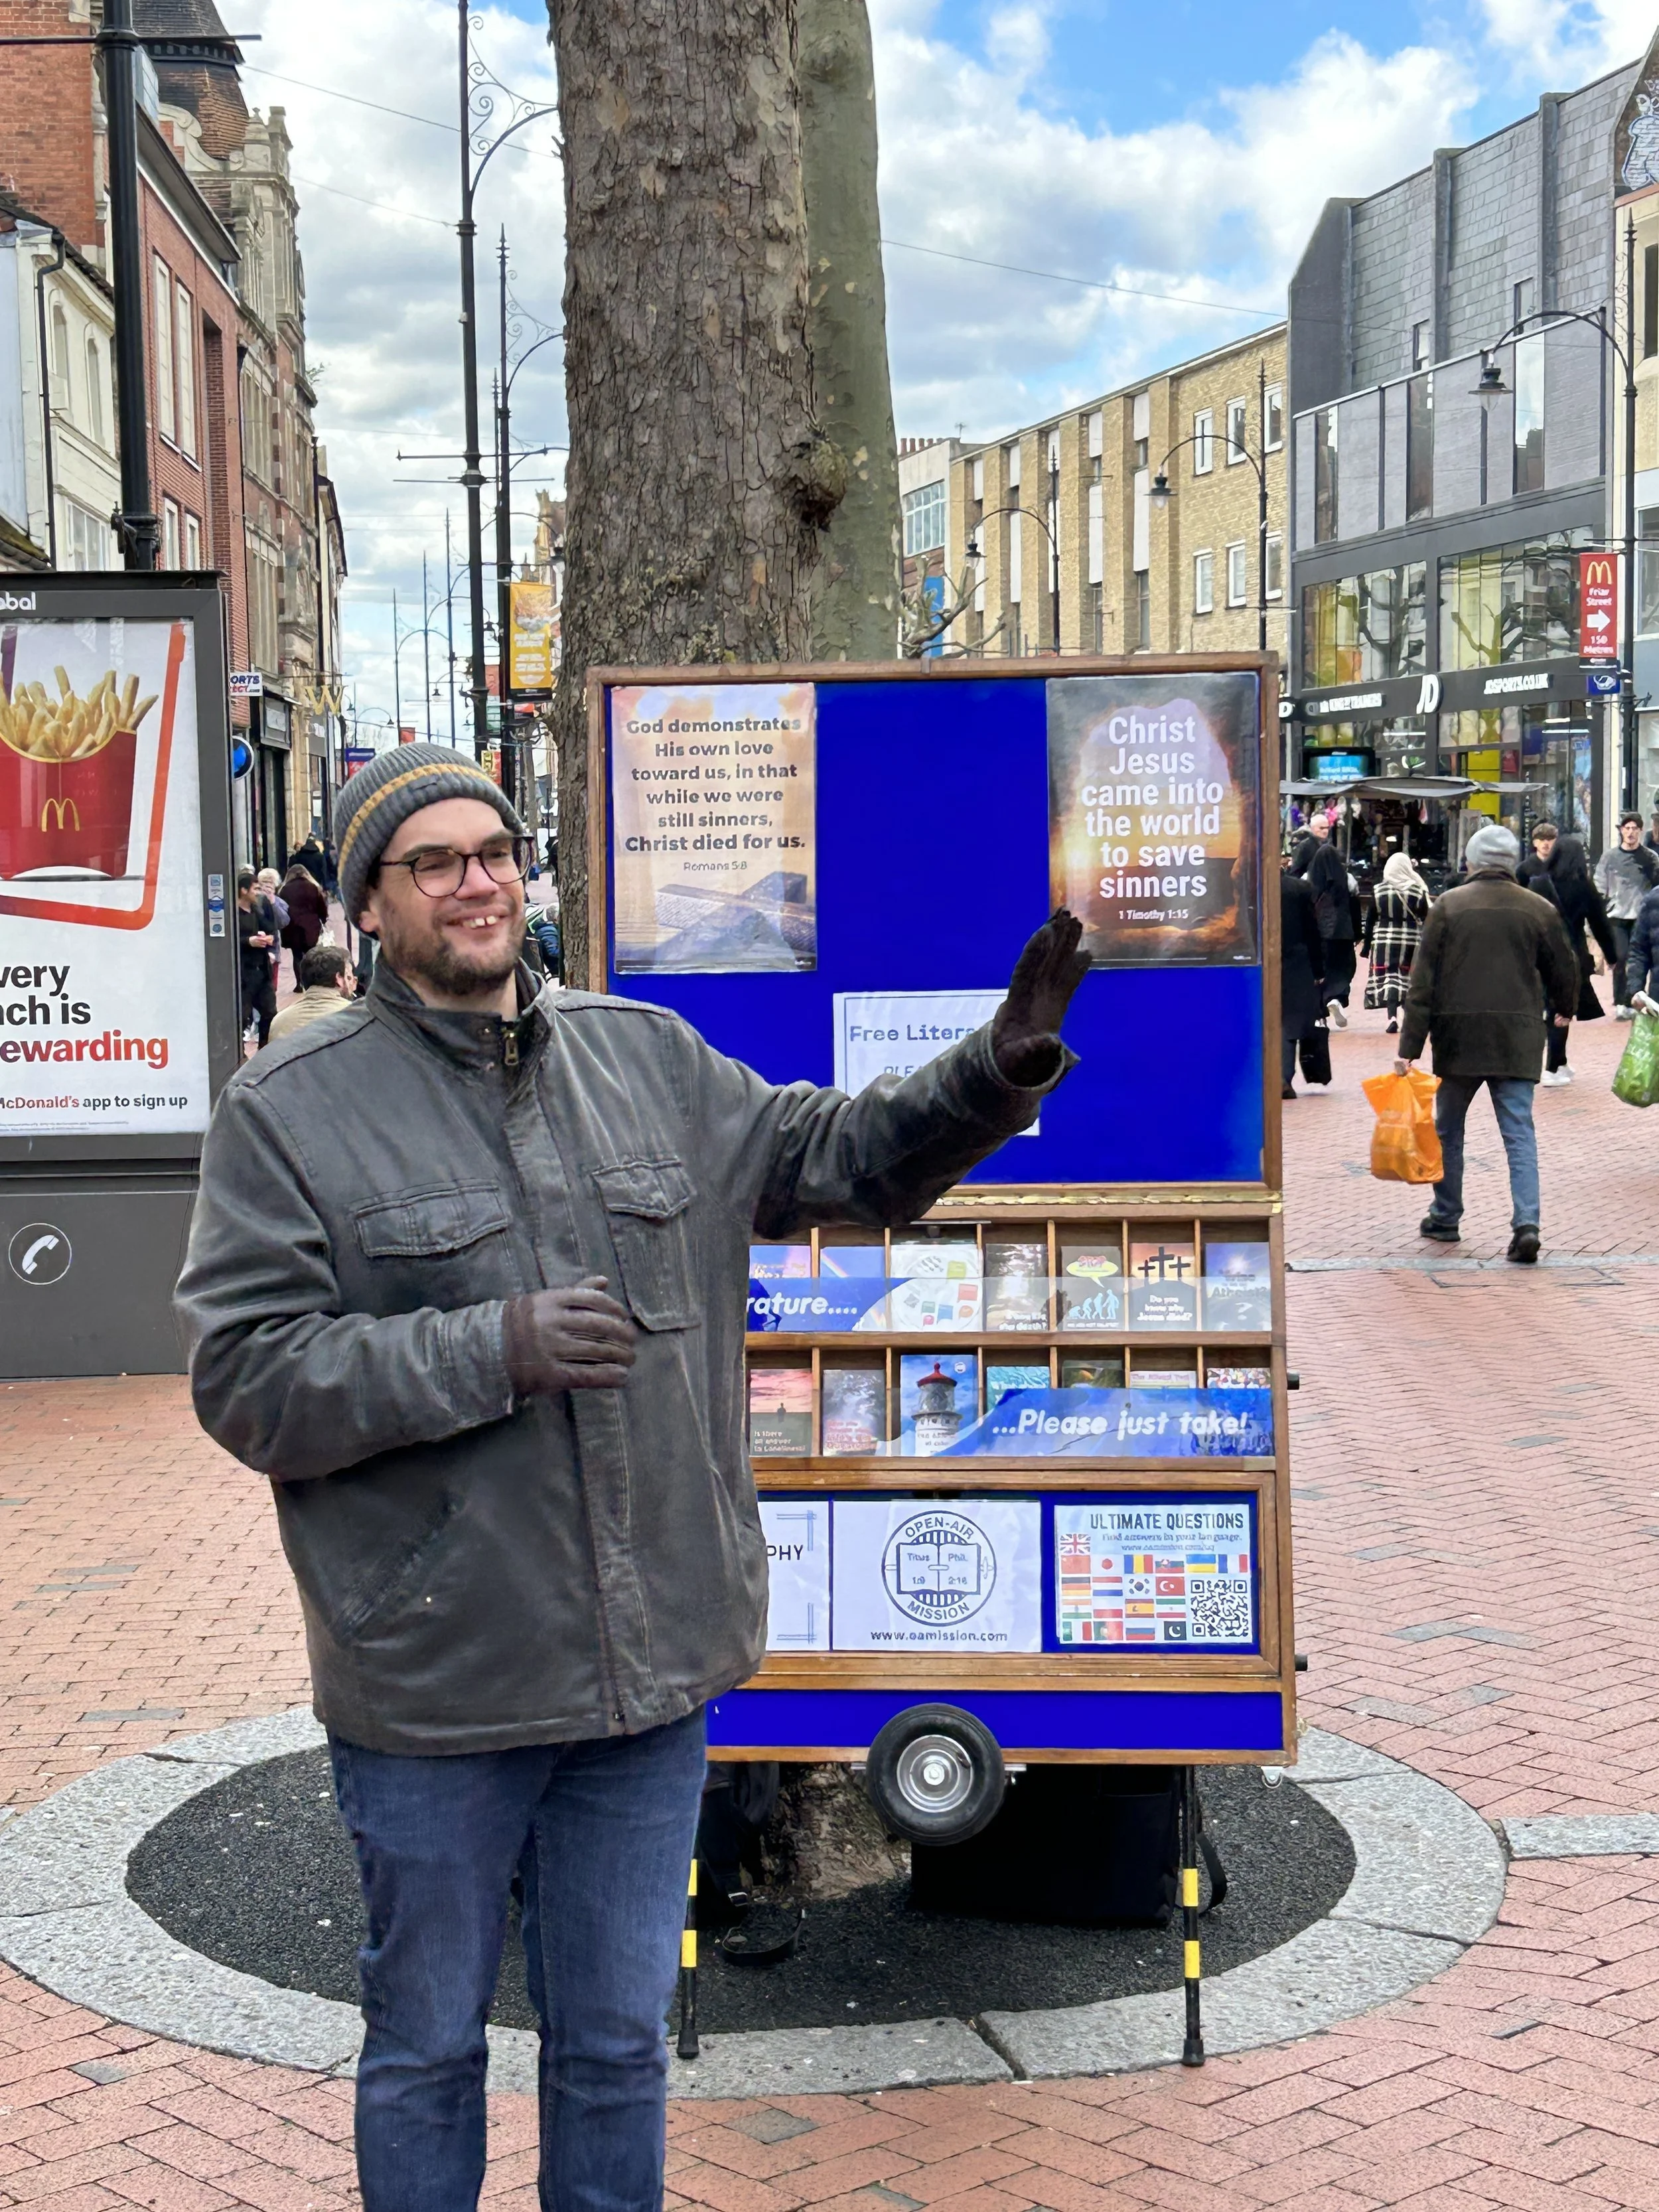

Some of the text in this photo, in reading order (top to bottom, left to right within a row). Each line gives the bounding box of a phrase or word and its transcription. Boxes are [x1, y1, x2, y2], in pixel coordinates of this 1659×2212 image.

[305, 686, 348, 715] W
[1416, 674, 1439, 714] JD
[626, 717, 801, 733] God demonstrates
[1109, 715, 1196, 744] Christ
[655, 741, 773, 757] His own love
[1109, 748, 1194, 775] Jesus
[632, 764, 797, 780] toward us, in that
[646, 789, 784, 804] while we were
[1082, 777, 1223, 806] came into
[658, 812, 772, 828] still sinners,
[1085, 806, 1220, 837] the world
[625, 834, 805, 851] Christ died for us.
[1100, 842, 1205, 867] to save
[684, 862, 729, 871] Romans
[1100, 871, 1207, 898] sinners
[1119, 909, 1189, 921] 1 Timothy 1:15
[0, 993, 91, 1025] ch is
[850, 1025, 899, 1041] Free
[0, 1029, 169, 1069] ewarding
[83, 1099, 111, 1111] app
[115, 1096, 129, 1108] to
[133, 1094, 166, 1110] sign
[169, 1097, 188, 1109] up
[1118, 1411, 1169, 1440] just
[1179, 1411, 1248, 1435] take!
[905, 1517, 974, 1540] OPEN-AIR
[1090, 1513, 1244, 1530] ULTIMATE QUESTIONS
[767, 1545, 803, 1560] PHY
[906, 1600, 970, 1620] MISSION
[871, 1631, 1008, 1641] www.oamission.com
